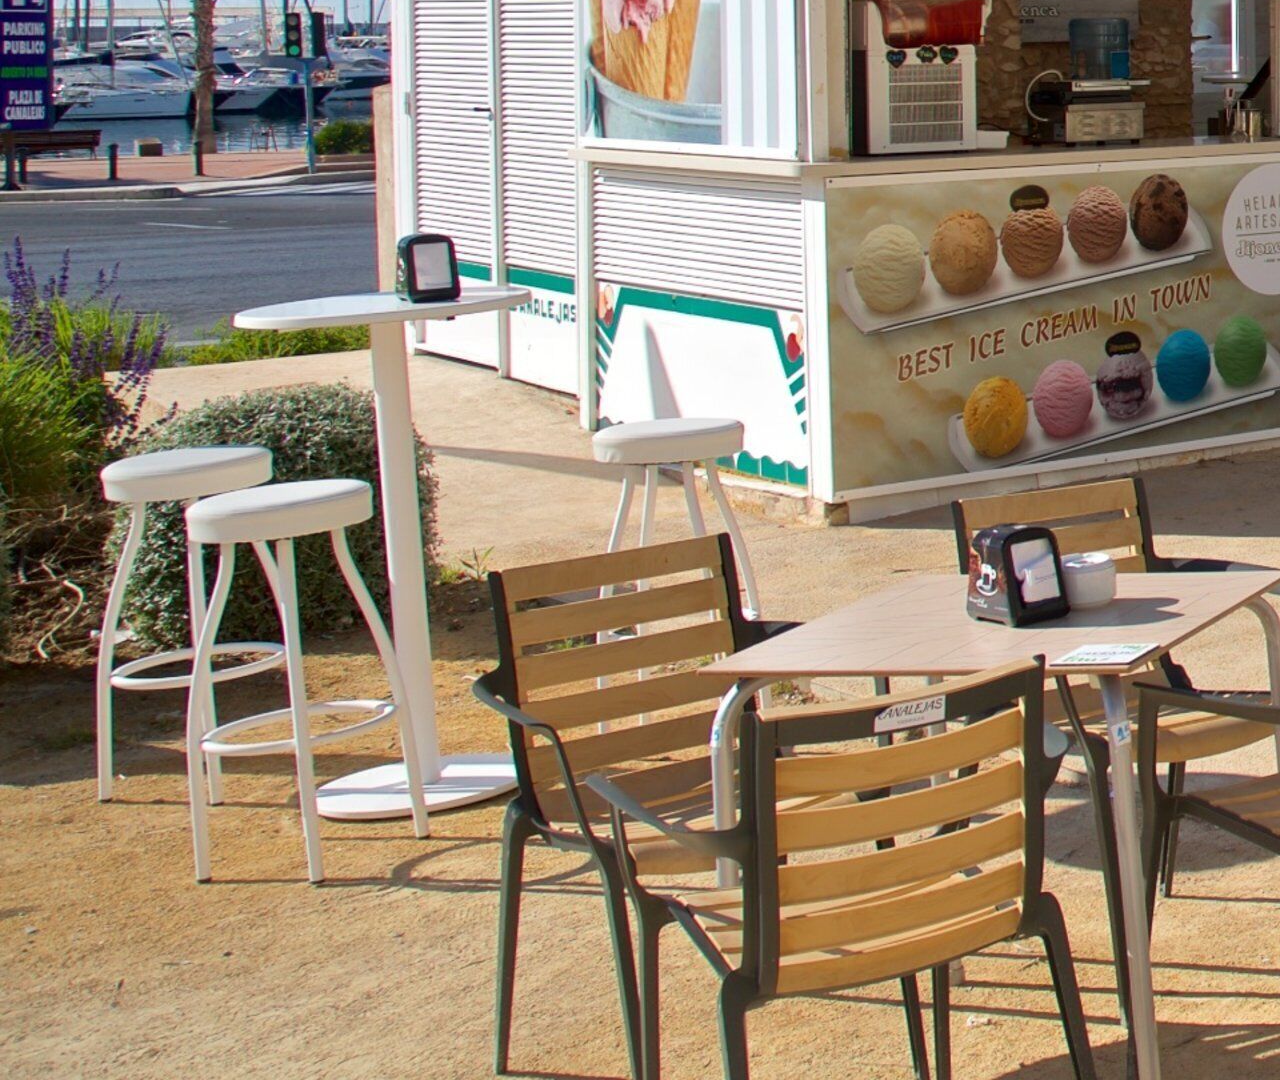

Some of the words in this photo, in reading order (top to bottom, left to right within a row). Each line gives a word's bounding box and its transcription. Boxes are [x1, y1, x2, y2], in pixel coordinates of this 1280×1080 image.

[3, 22, 46, 36] PARKING
[8, 90, 34, 105] PLAZA
[897, 343, 955, 382] BEST
[969, 329, 1006, 362] ICE
[1020, 305, 1099, 348] CREAM
[1112, 294, 1138, 324] IN
[1150, 274, 1213, 312] TOWN
